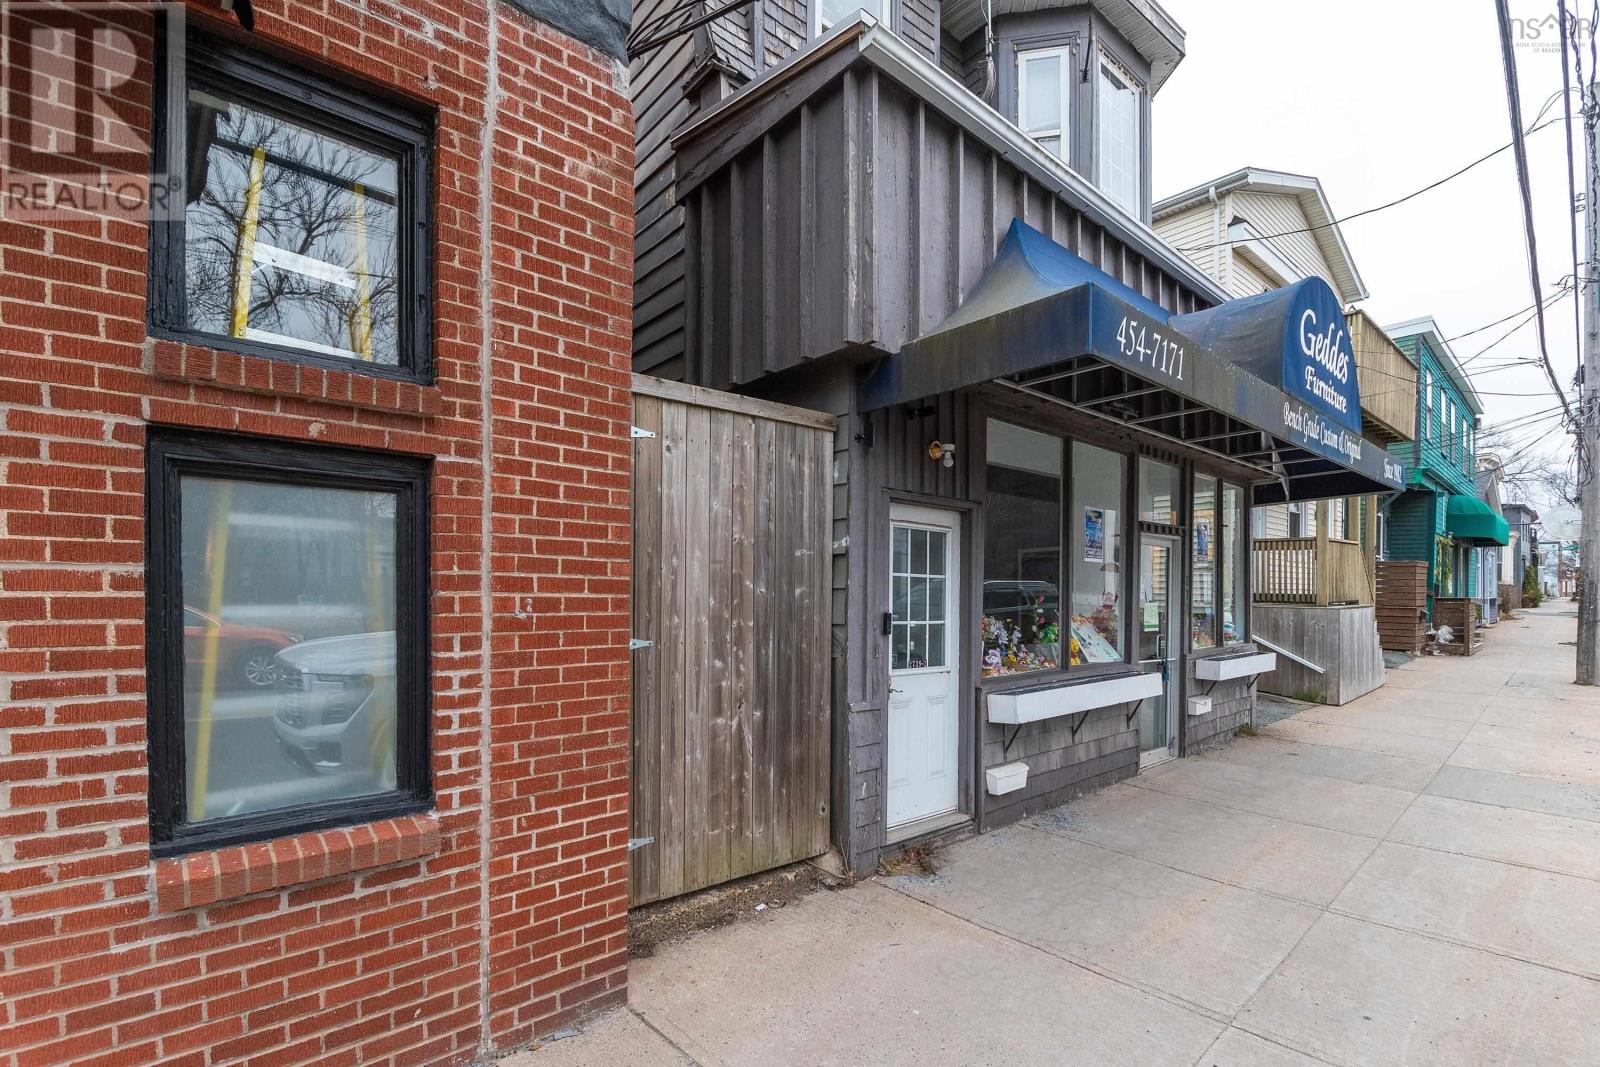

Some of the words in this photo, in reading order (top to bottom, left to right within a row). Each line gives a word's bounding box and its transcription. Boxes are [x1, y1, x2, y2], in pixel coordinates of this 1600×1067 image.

[1116, 315, 1184, 381] 454-7171
[1300, 308, 1349, 385] Geddes
[1304, 365, 1347, 414] Furniture
[1283, 401, 1303, 432] Bench
[1303, 412, 1320, 443] Grade
[1320, 421, 1338, 450] Custom
[1344, 434, 1362, 465] Original
